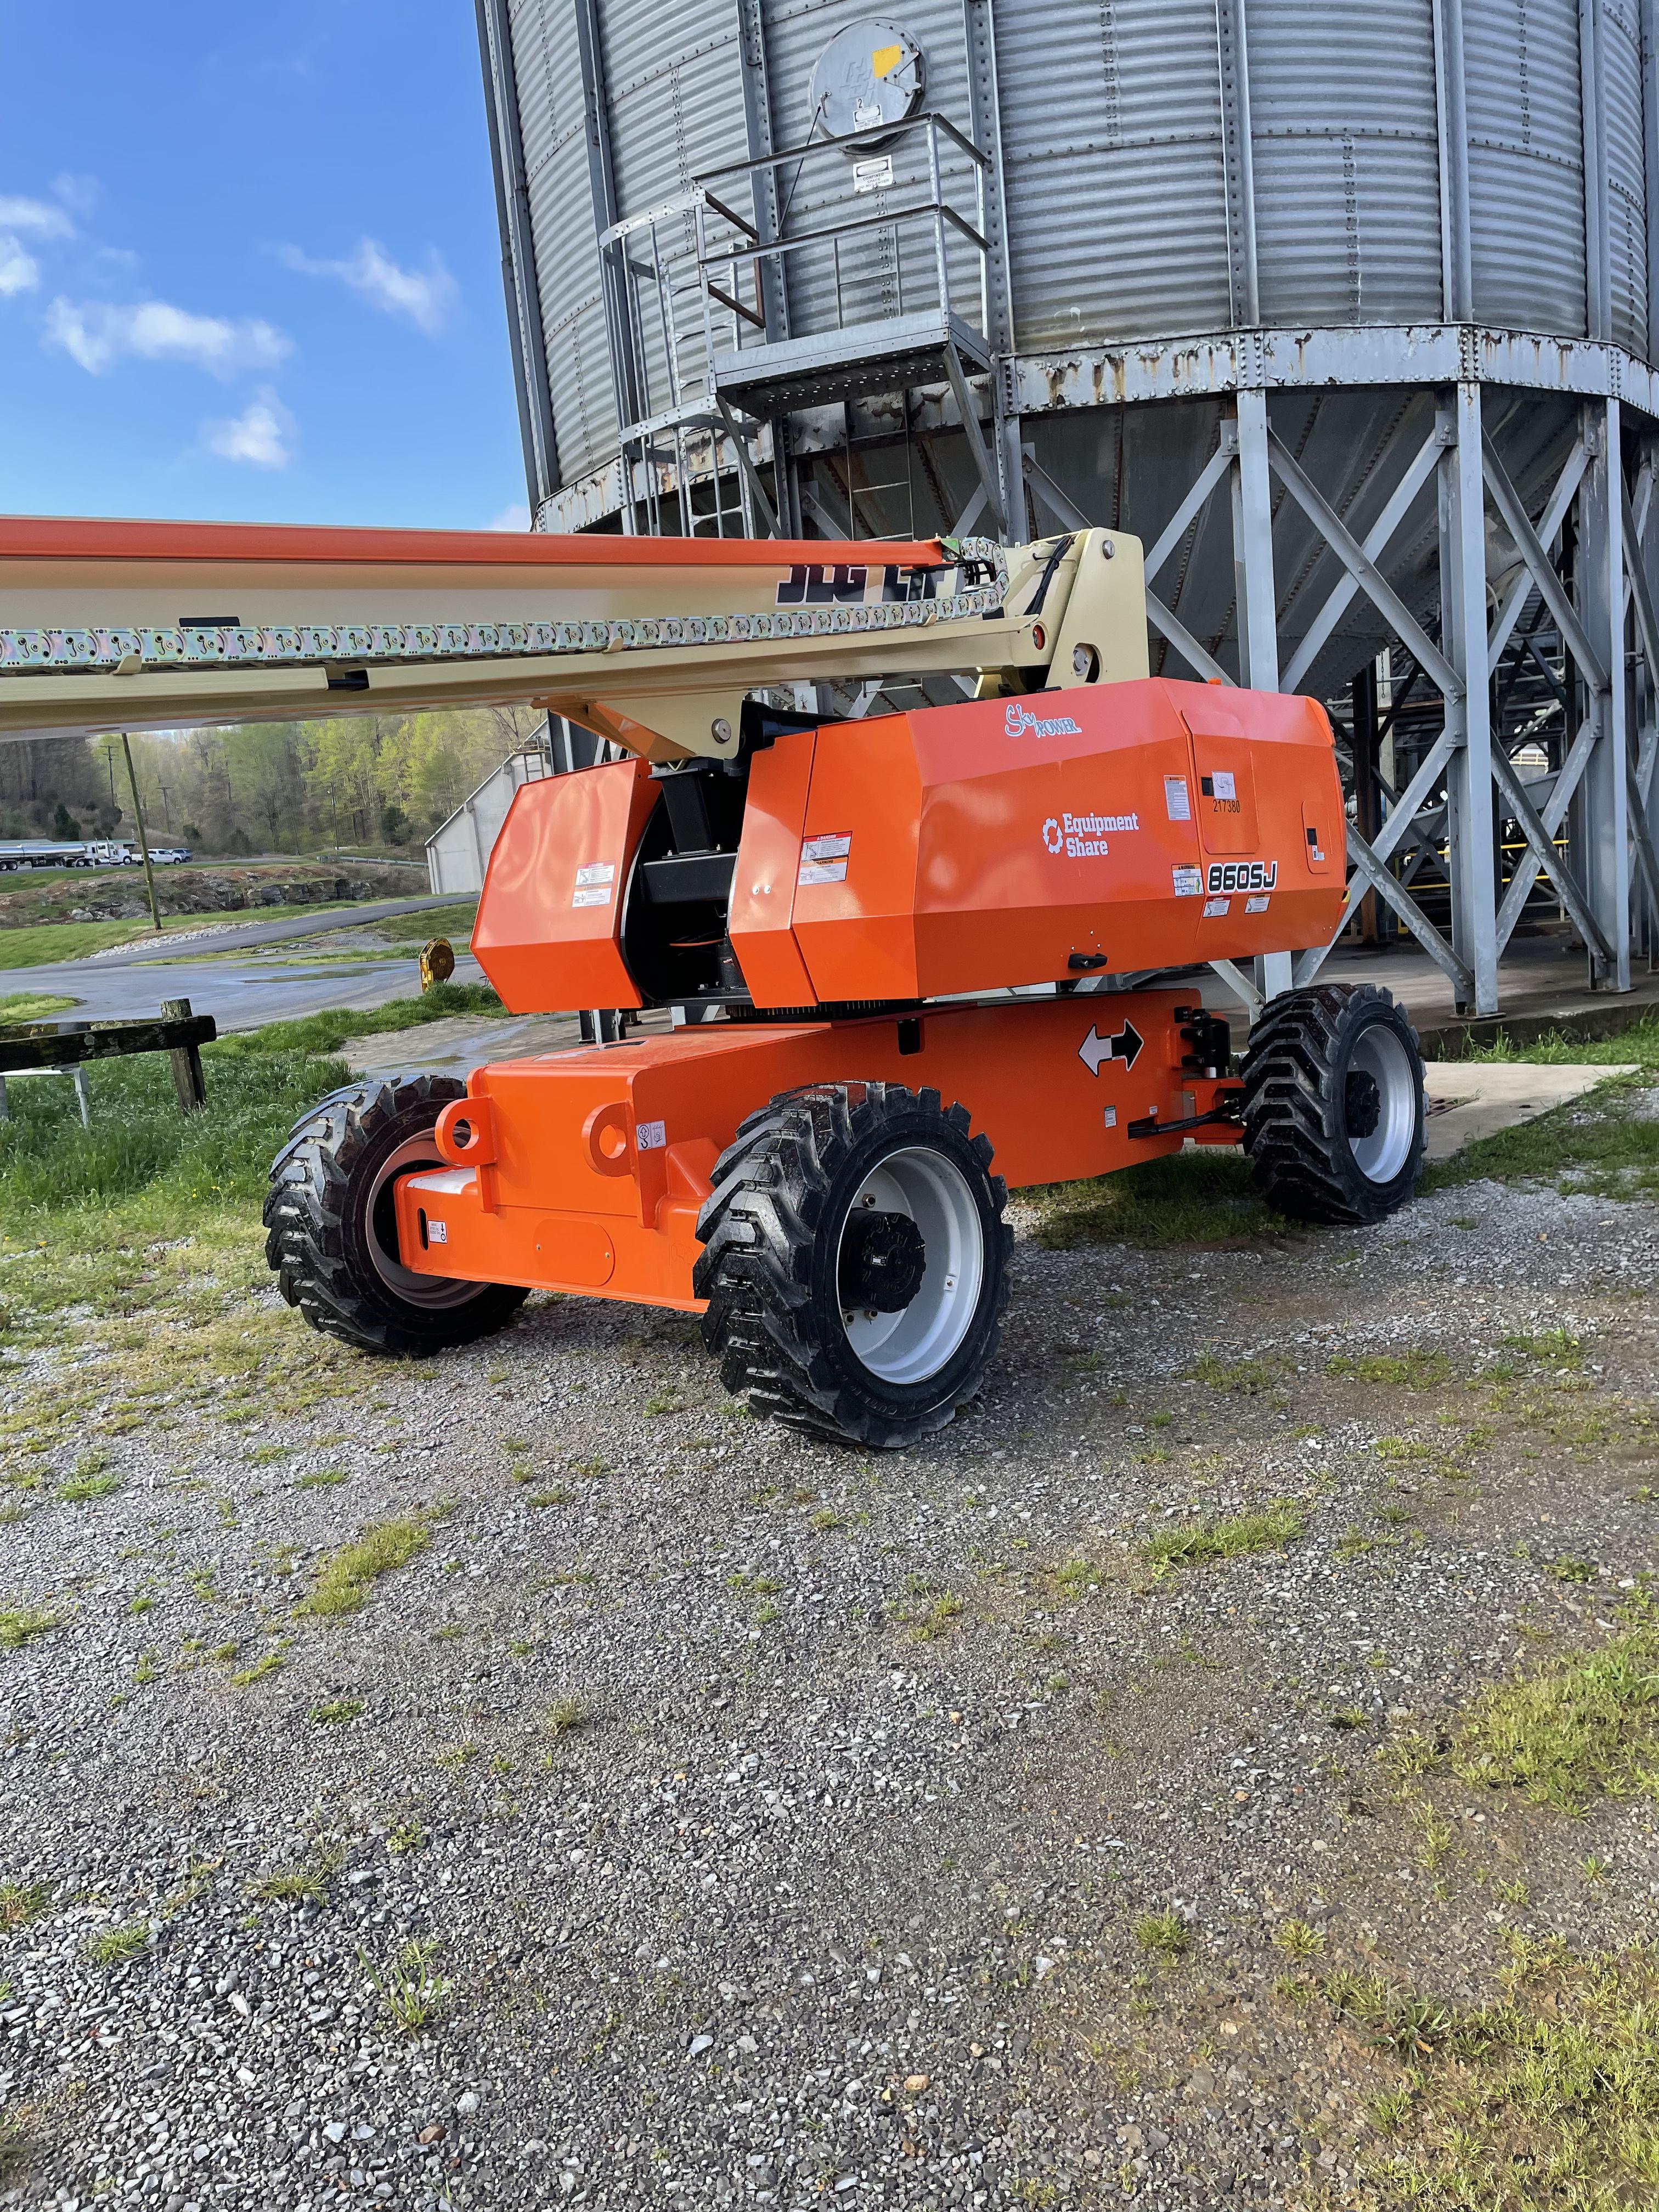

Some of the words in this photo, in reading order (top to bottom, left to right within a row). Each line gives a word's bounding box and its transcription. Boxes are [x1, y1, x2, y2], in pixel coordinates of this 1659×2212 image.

[857, 98, 862, 109] 2
[862, 172, 884, 181] CONFINED
[1212, 799, 1240, 813] 217380
[1062, 812, 1139, 837] Equipment
[1066, 837, 1109, 857] Share
[1208, 861, 1277, 894] 860SJ
